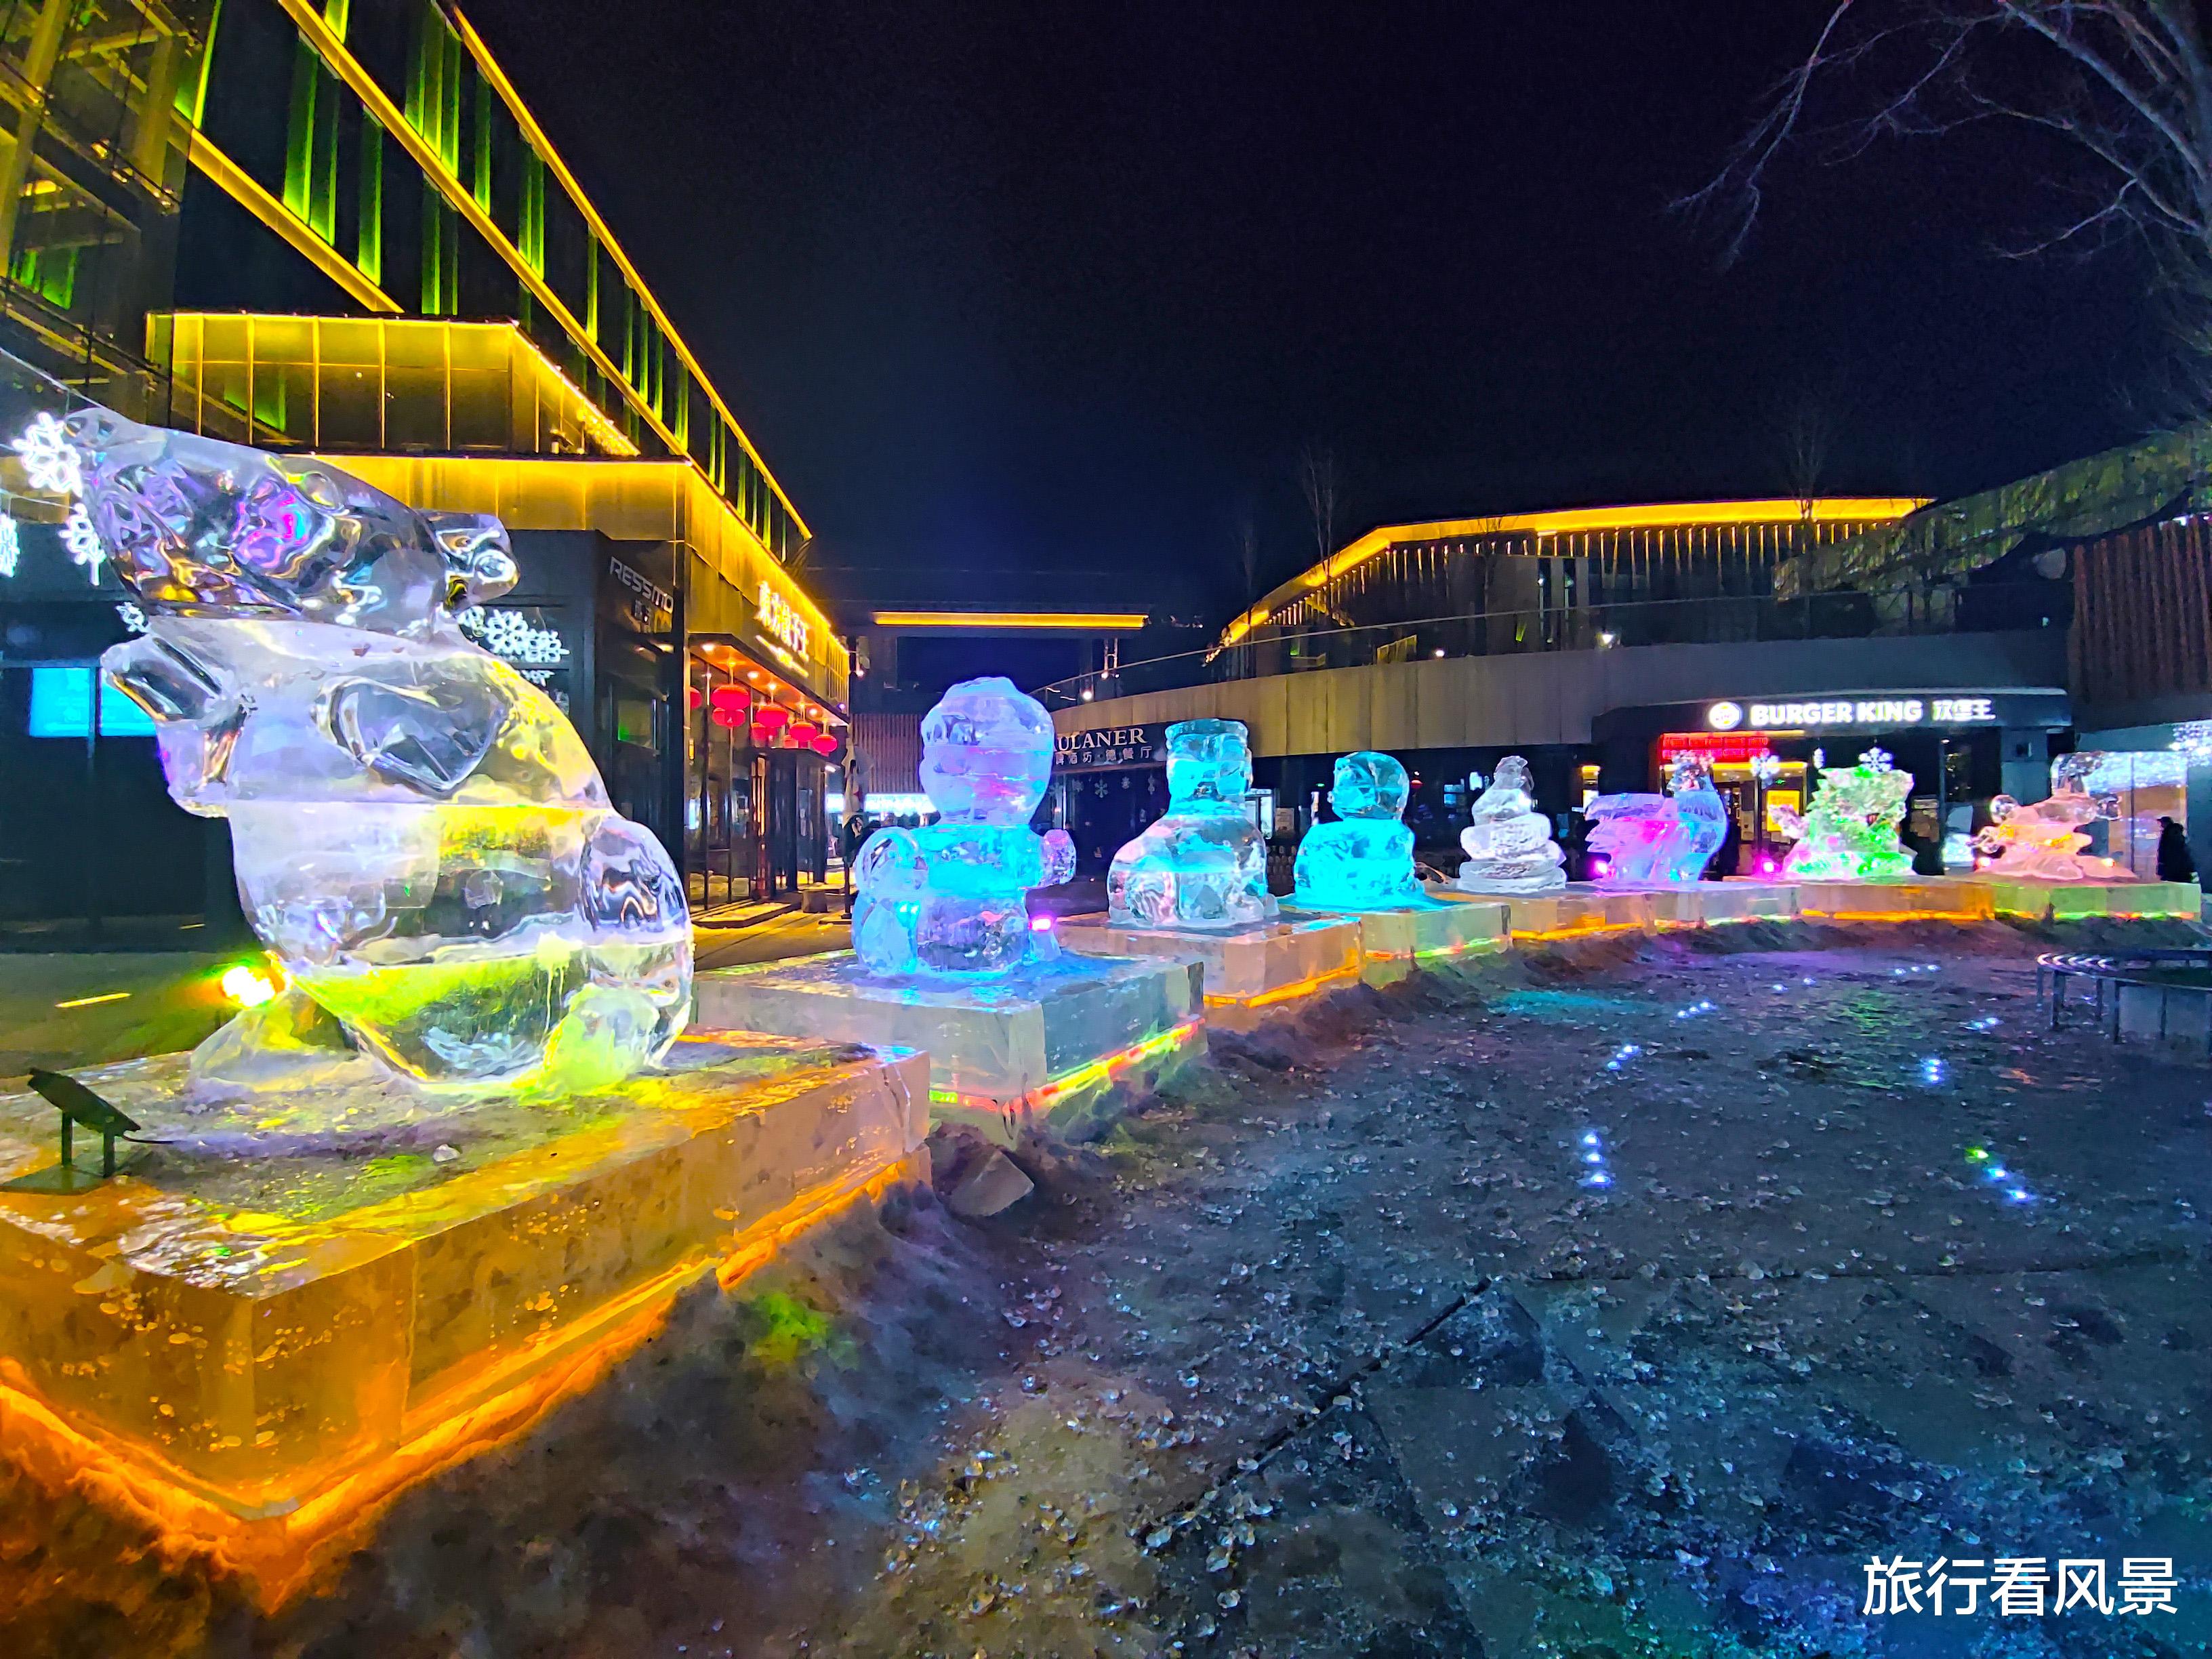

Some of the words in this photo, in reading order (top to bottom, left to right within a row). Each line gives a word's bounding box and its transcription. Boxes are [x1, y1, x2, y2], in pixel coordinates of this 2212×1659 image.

[1750, 701, 1854, 726] BURGER
[1856, 699, 1924, 722] KING
[1054, 728, 1147, 752] ULANER
